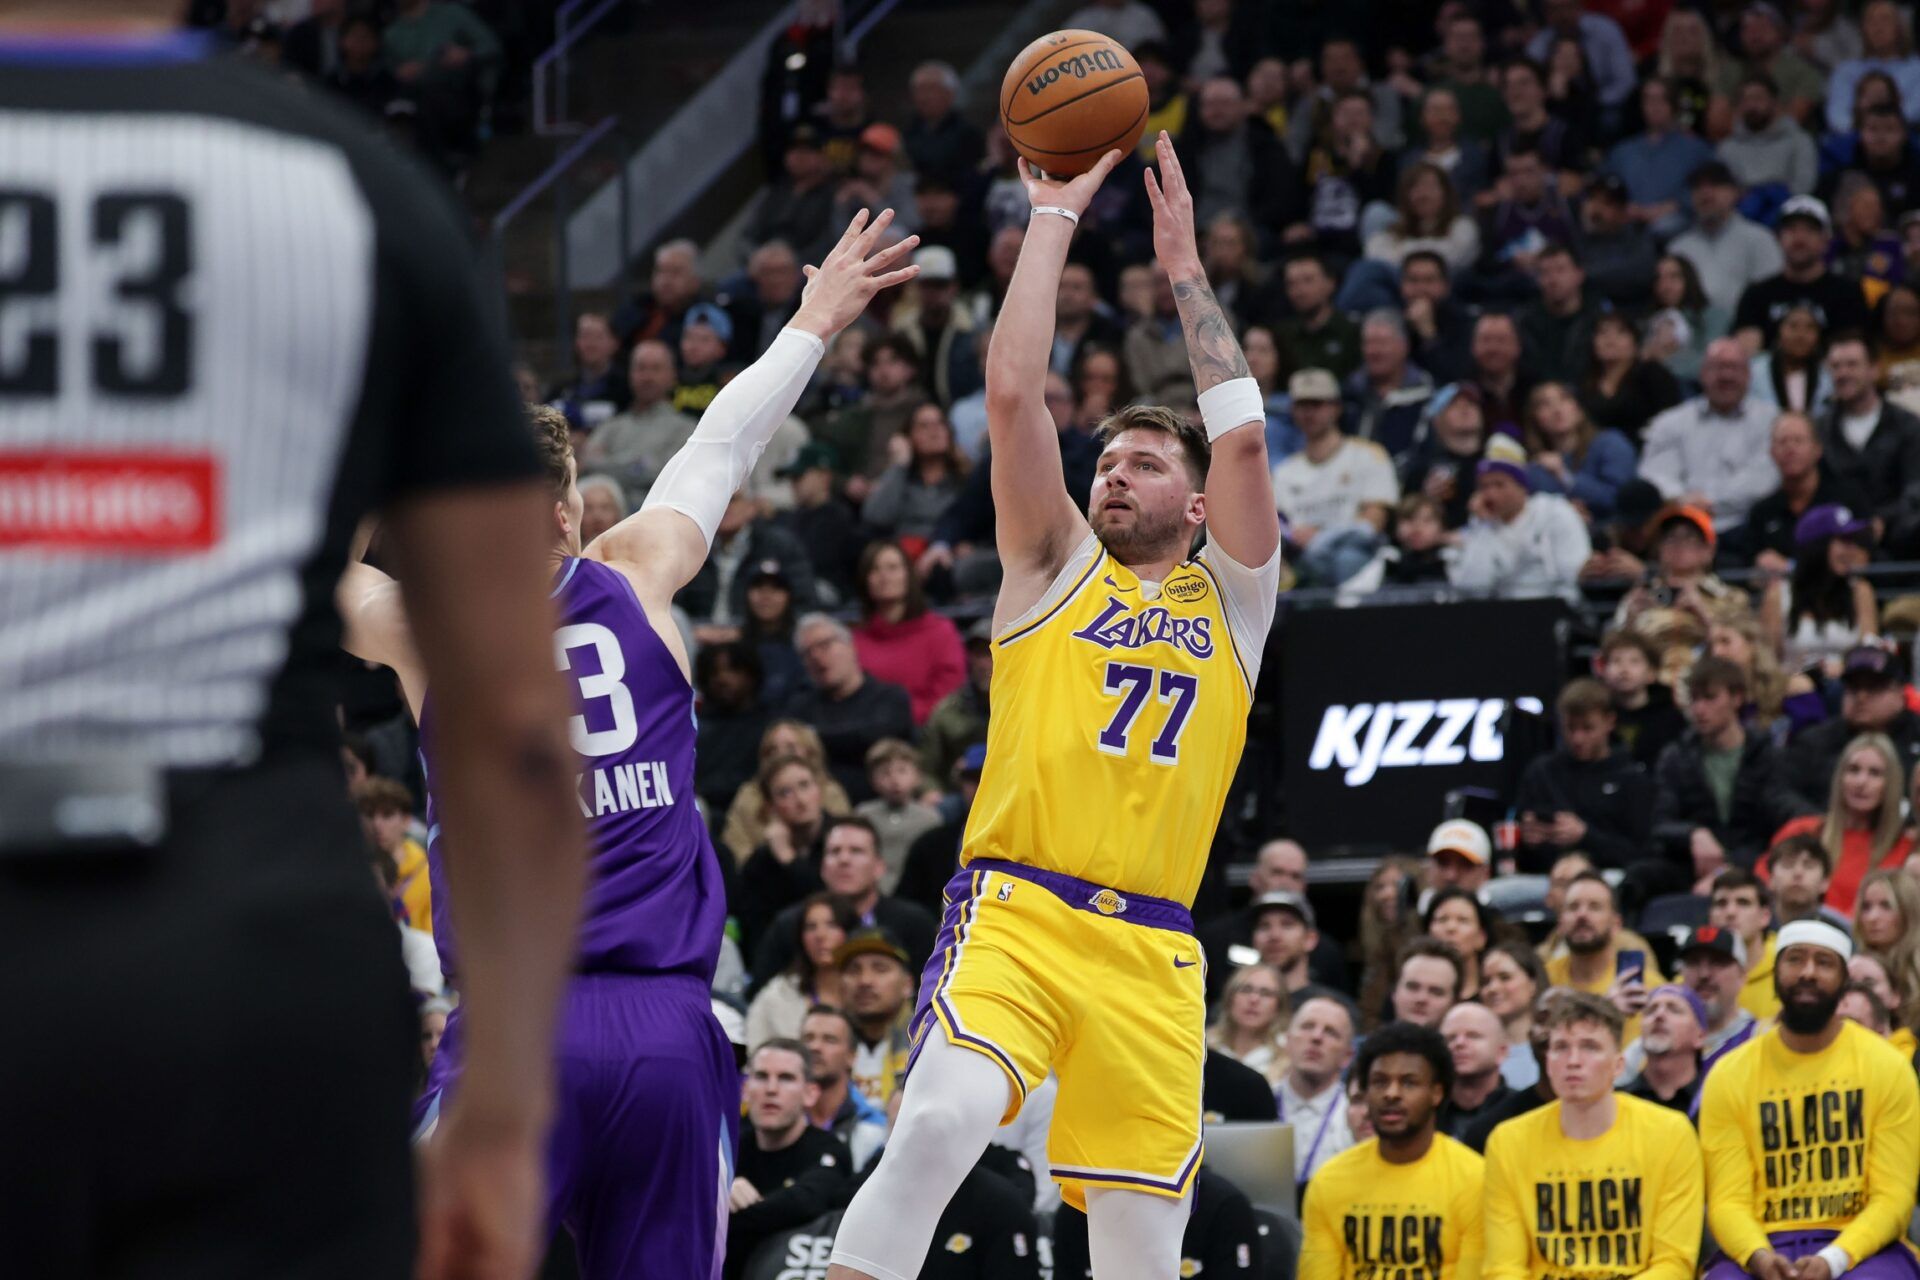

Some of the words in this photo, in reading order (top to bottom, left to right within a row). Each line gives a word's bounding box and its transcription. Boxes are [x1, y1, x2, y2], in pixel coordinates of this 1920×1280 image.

[1026, 49, 1125, 96] Wilson
[1168, 581, 1206, 595] bibigo
[1071, 595, 1215, 660] LAKERS
[1098, 661, 1198, 766] 77
[1760, 1088, 1865, 1152] BLACK
[1764, 1144, 1865, 1188] HISTORY
[1536, 1177, 1642, 1233] BLACK
[1344, 1214, 1444, 1267] BLACK
